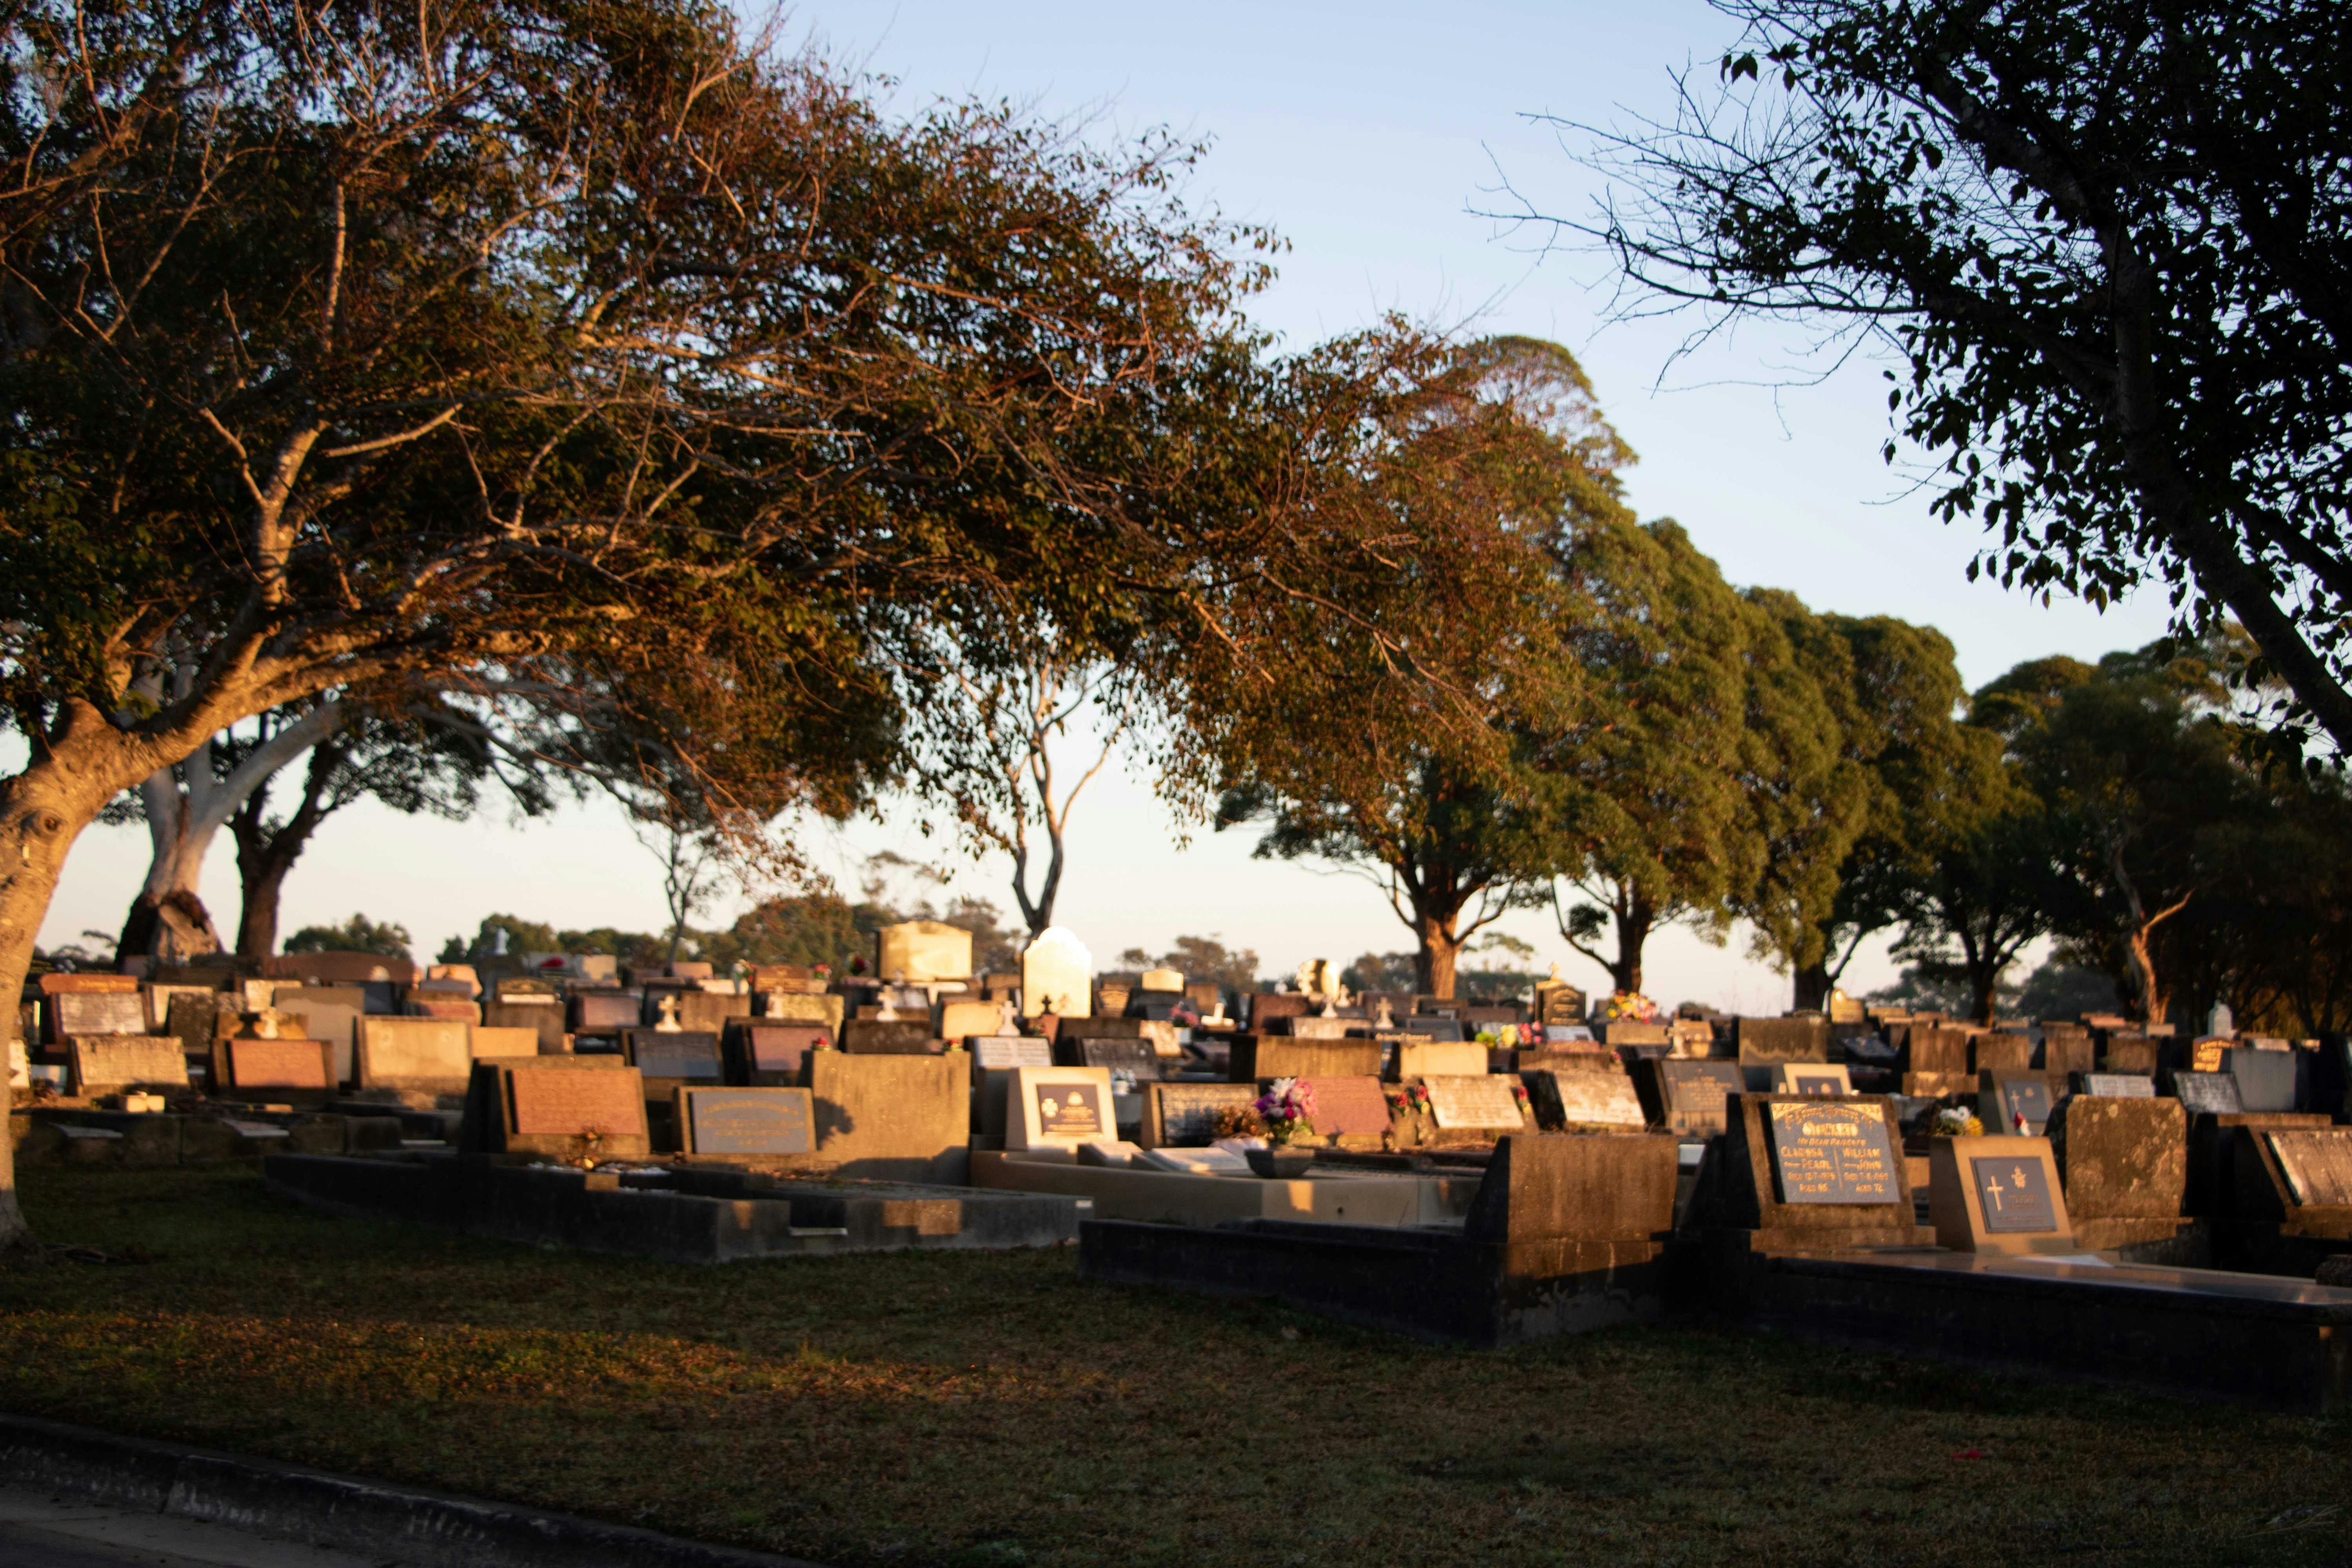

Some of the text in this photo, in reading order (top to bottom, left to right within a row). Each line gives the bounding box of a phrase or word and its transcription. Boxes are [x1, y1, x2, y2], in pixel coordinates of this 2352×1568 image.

[1843, 1147, 1881, 1158] WILLIAM
[1802, 1159, 1833, 1170] PEARL
[1857, 1160, 1882, 1170] JOHN
